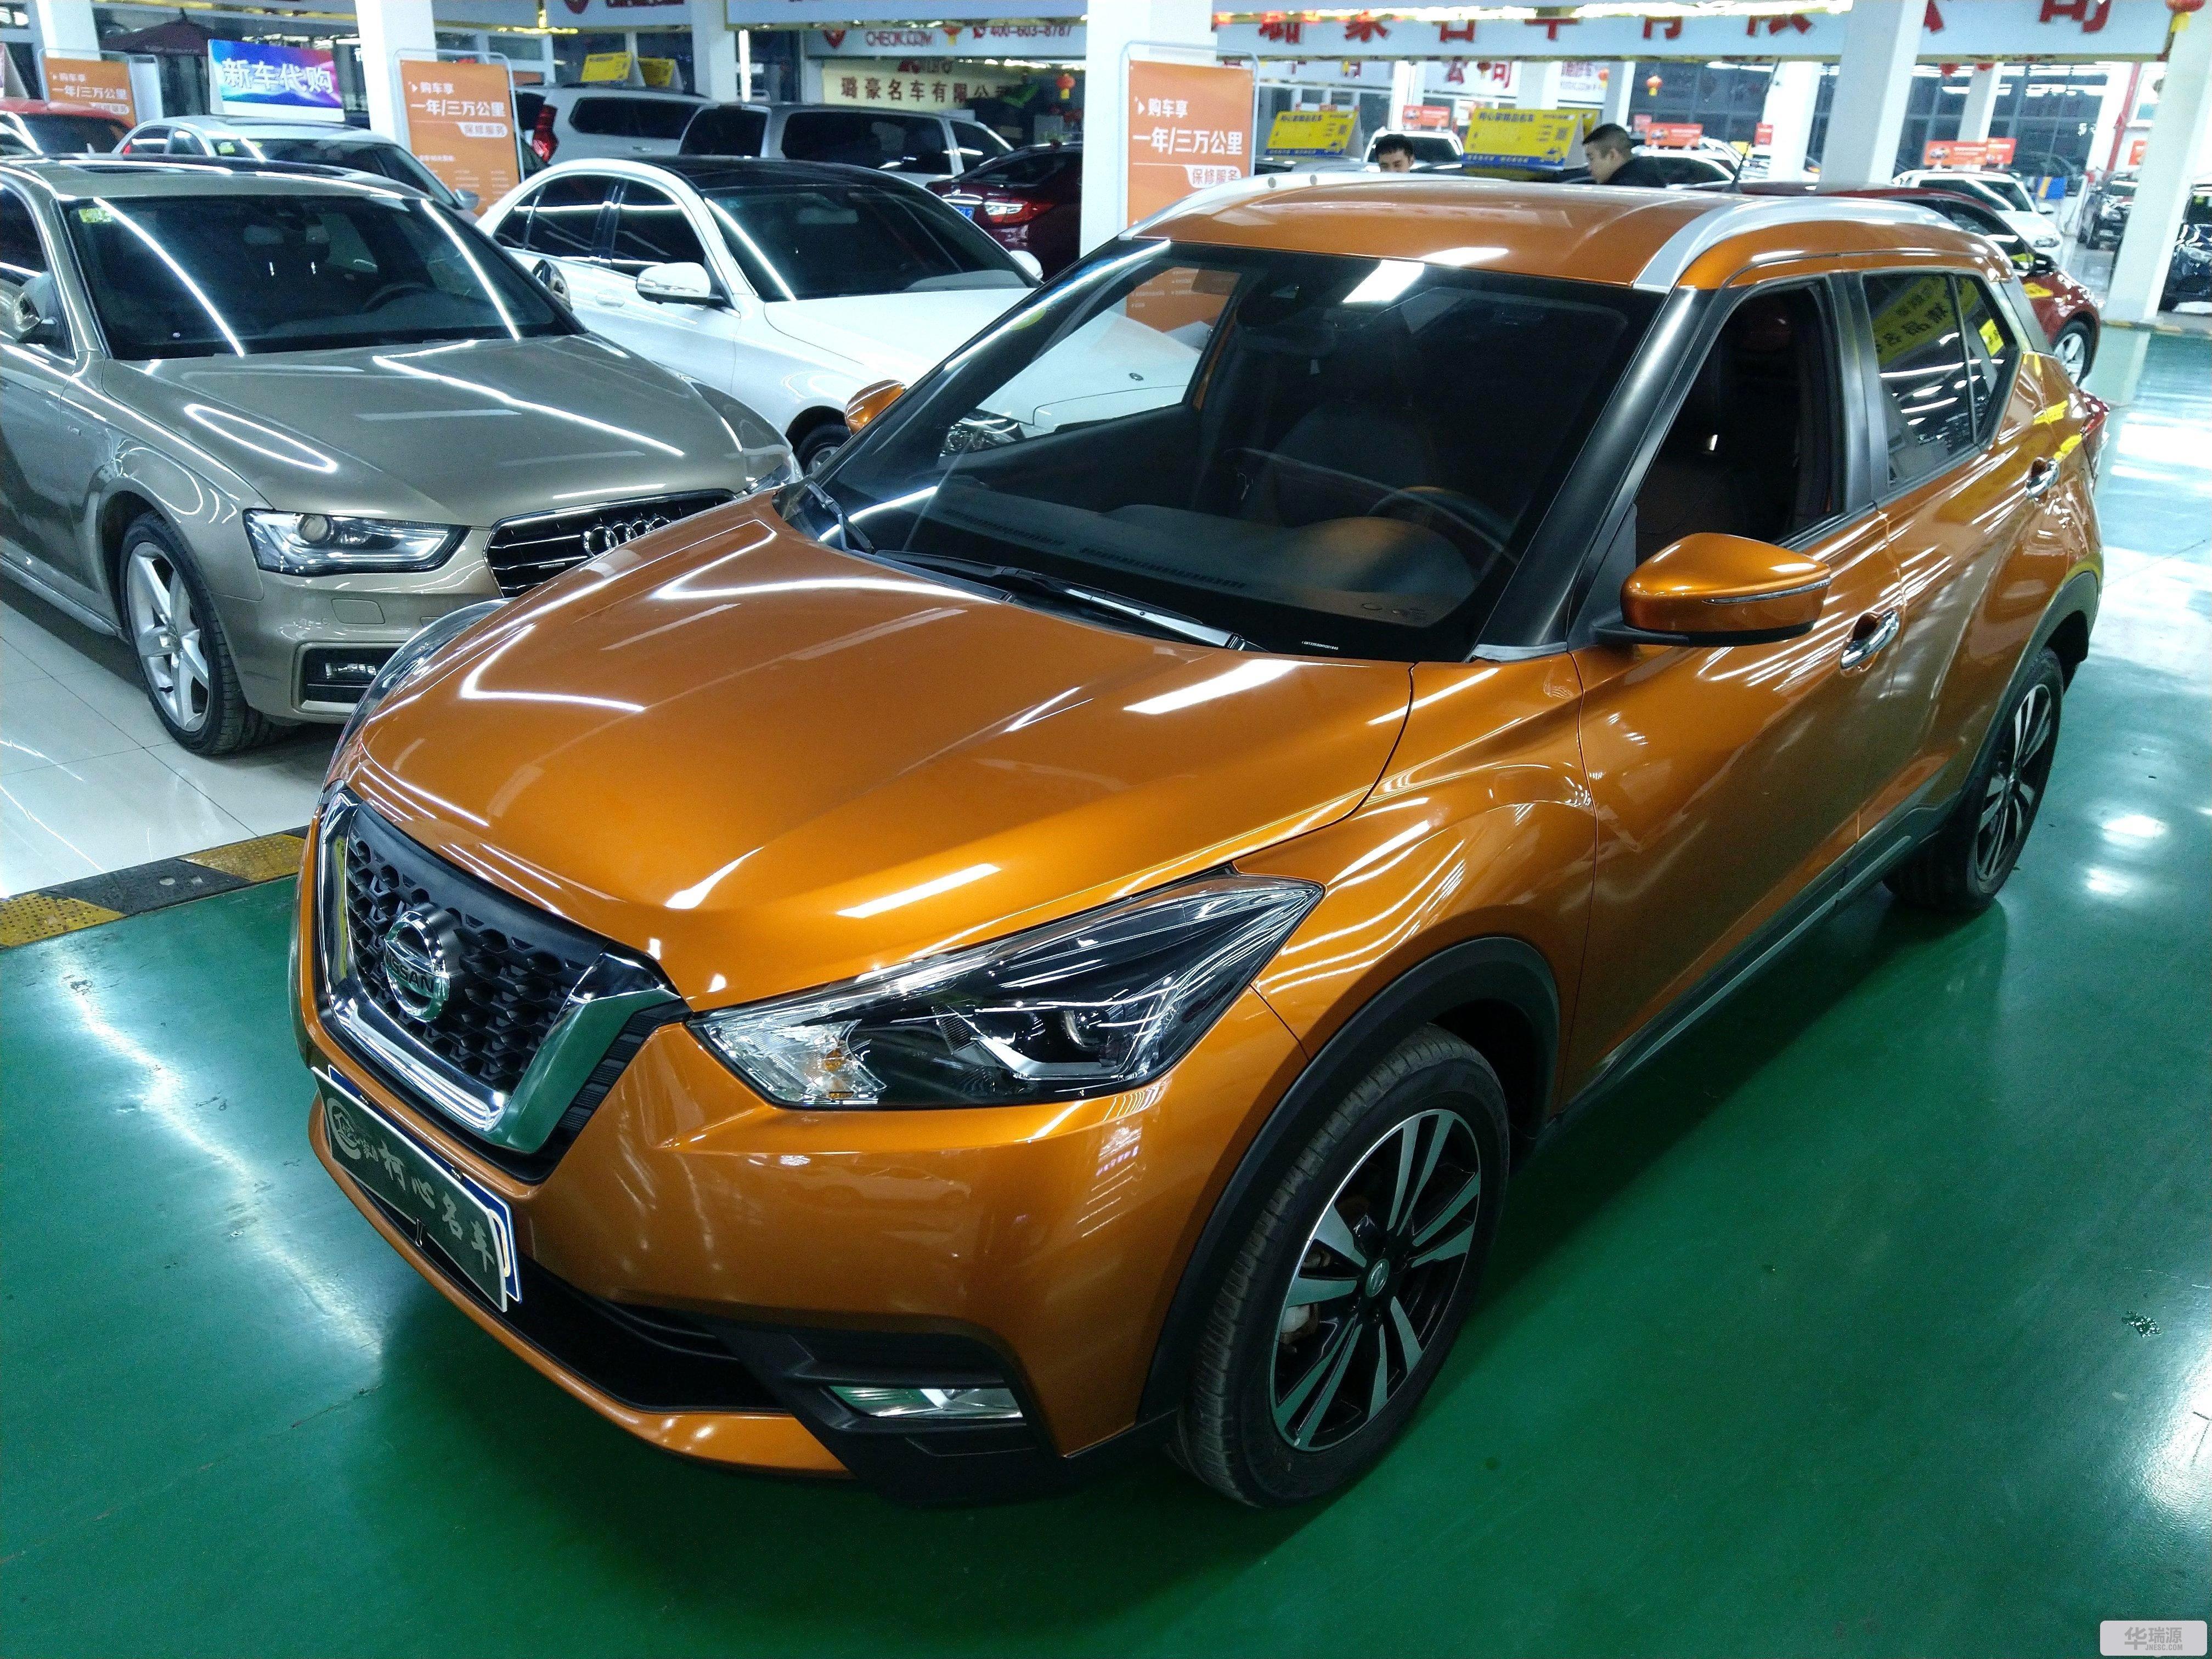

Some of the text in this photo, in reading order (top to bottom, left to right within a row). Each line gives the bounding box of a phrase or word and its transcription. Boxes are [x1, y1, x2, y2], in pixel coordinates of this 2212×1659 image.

[222, 58, 334, 93] 新车代购
[410, 99, 506, 117] 一年/三万公里
[1148, 98, 1188, 119] 购车享
[1133, 127, 1243, 155] 一年/三万公里
[385, 946, 435, 995] NISSAN
[380, 1138, 495, 1273] 柯心名车
